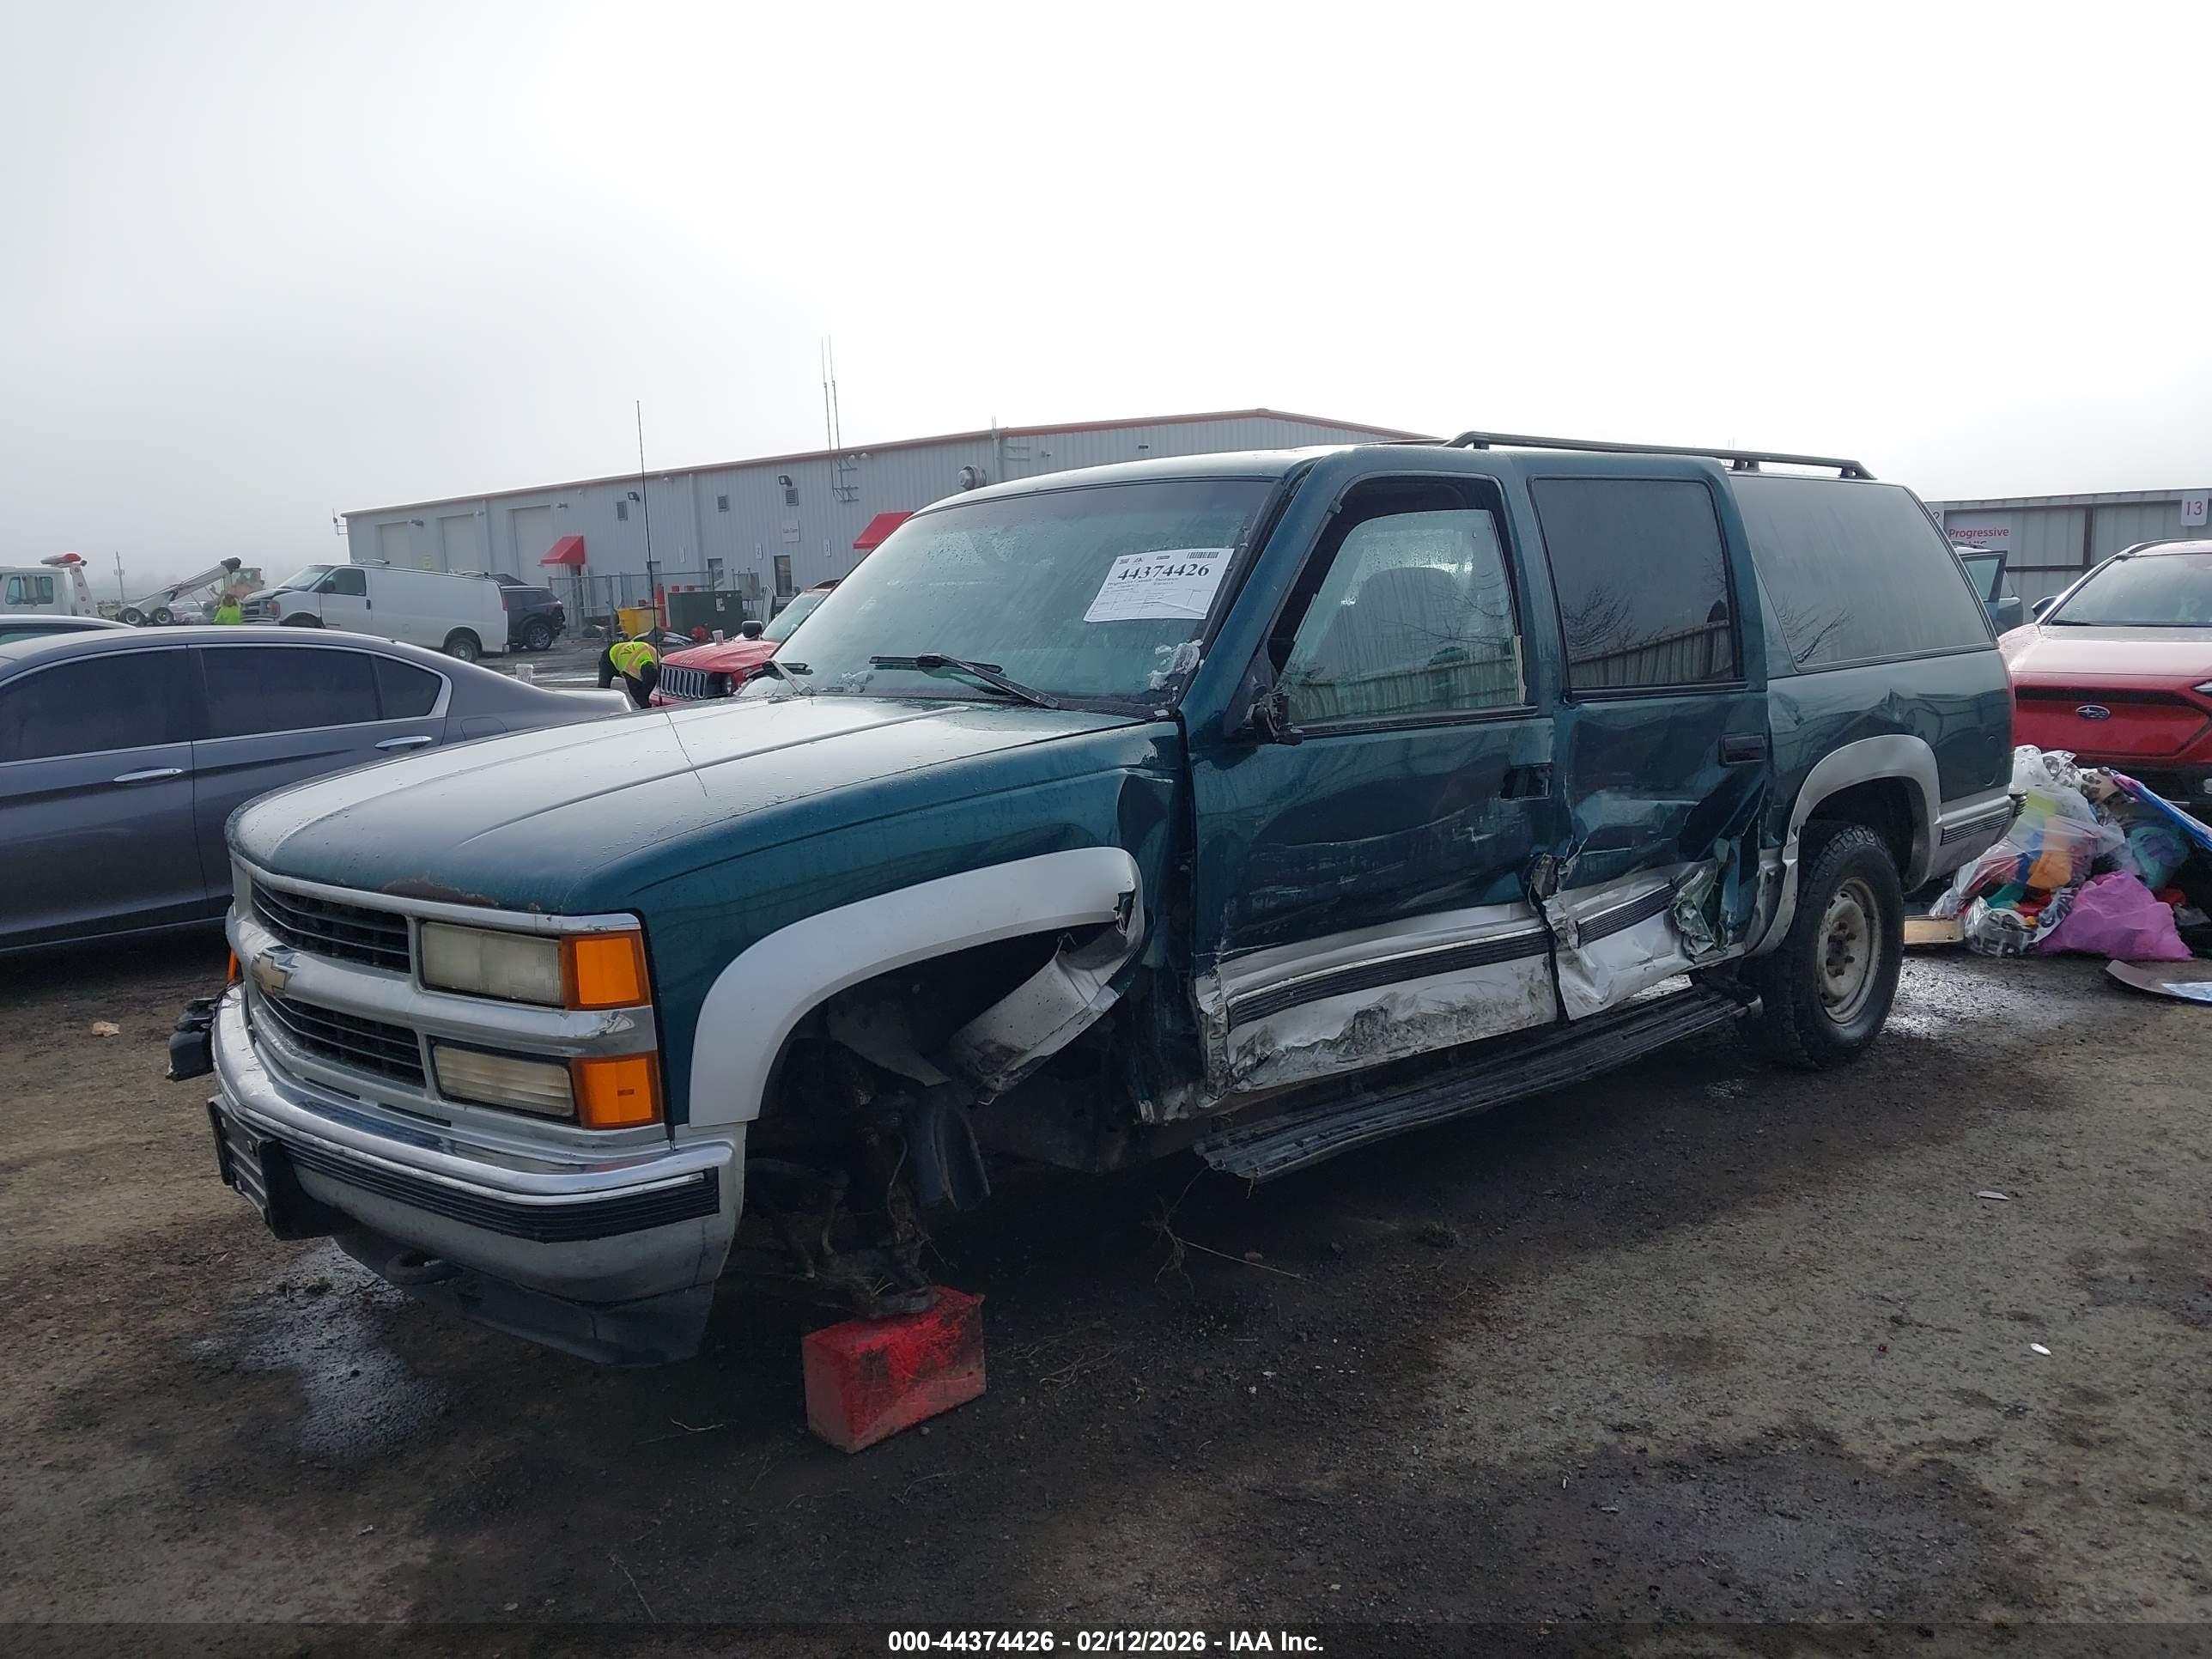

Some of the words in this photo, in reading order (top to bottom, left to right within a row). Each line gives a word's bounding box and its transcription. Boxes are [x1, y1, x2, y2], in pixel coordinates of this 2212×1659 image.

[2186, 501, 2203, 516] 13
[1948, 527, 2009, 538] Progressive
[1117, 562, 1212, 581] 44374426
